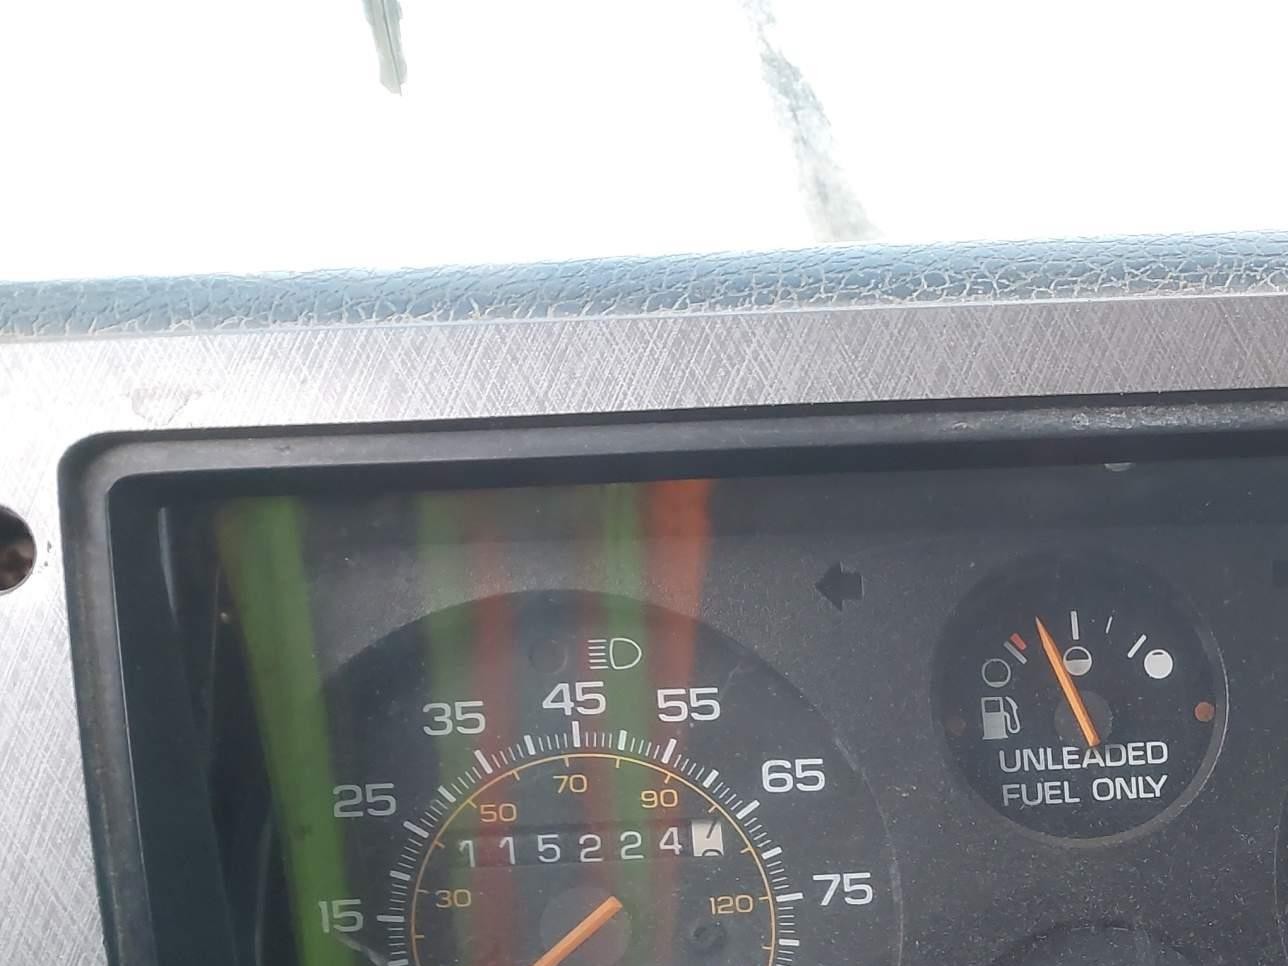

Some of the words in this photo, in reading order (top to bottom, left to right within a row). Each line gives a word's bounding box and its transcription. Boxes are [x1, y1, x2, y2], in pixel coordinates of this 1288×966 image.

[542, 681, 607, 715] 45
[657, 687, 721, 721] 55
[422, 701, 486, 736] 35
[999, 741, 1168, 773] UNLEADED
[552, 775, 588, 792] 70
[761, 758, 826, 792] 65
[1002, 781, 1080, 806] FUEL
[1092, 775, 1168, 801] ONLY
[332, 783, 397, 817] 25
[479, 803, 518, 822] 50
[640, 789, 679, 808] 90
[434, 889, 472, 908] 30
[709, 894, 754, 915] 120
[812, 872, 874, 905] 75
[319, 900, 364, 932] 15
